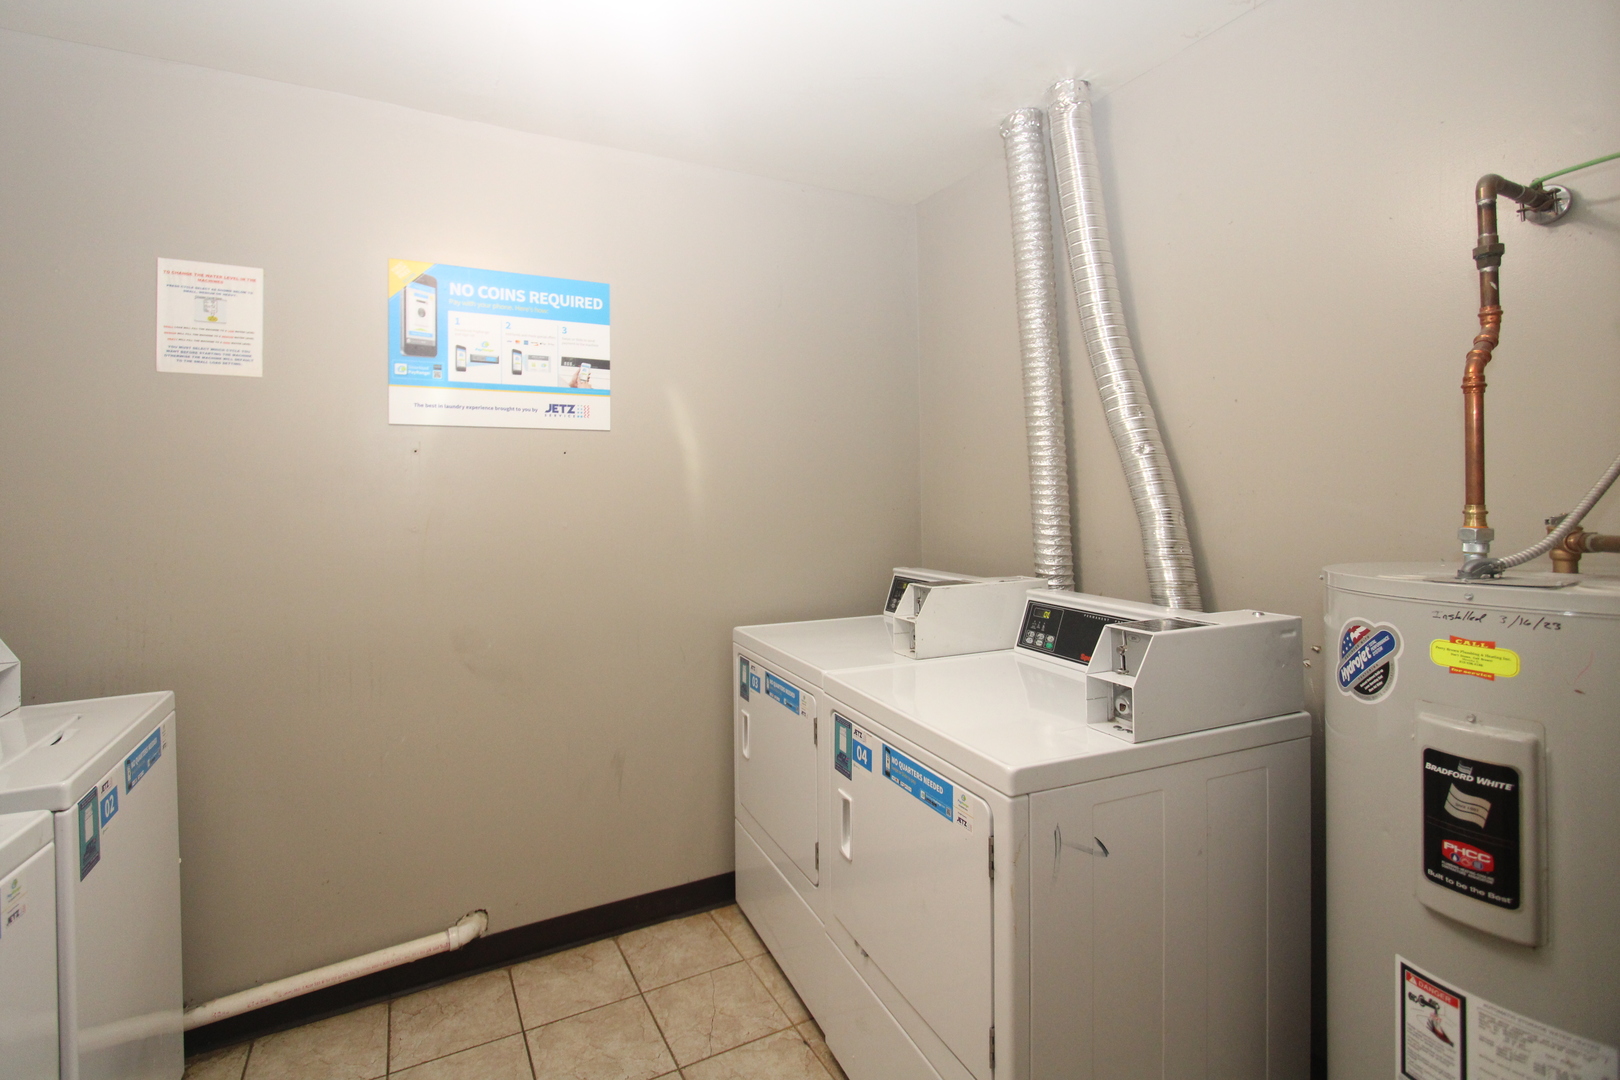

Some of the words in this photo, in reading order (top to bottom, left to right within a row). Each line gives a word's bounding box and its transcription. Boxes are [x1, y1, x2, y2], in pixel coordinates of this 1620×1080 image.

[449, 282, 474, 297] NO
[478, 286, 526, 303] COINS
[529, 291, 604, 310] REQUIRED
[505, 322, 512, 330] 2
[562, 326, 568, 334] 3
[545, 404, 576, 414] JETZ
[1432, 610, 1487, 623] Installed
[1455, 639, 1489, 648] CALL
[1340, 645, 1372, 682] Hydrojet
[1463, 670, 1492, 678] service
[752, 676, 758, 689] 03
[854, 728, 863, 738] JETZ
[856, 745, 868, 765] 04
[892, 756, 898, 766] NO
[899, 760, 923, 782] QUARTERS
[923, 776, 944, 795] NEEDED
[1425, 762, 1474, 782] BRADFORD
[1476, 776, 1513, 792] WHITE
[104, 794, 115, 818] 02
[956, 816, 968, 828] JETZ
[1443, 841, 1492, 864] PHCC
[1427, 868, 1445, 881] Built
[1446, 876, 1455, 886] to
[1456, 880, 1468, 891] be
[1470, 885, 1486, 896] the
[1488, 891, 1511, 904] Best
[1418, 980, 1452, 1004] DANGER
